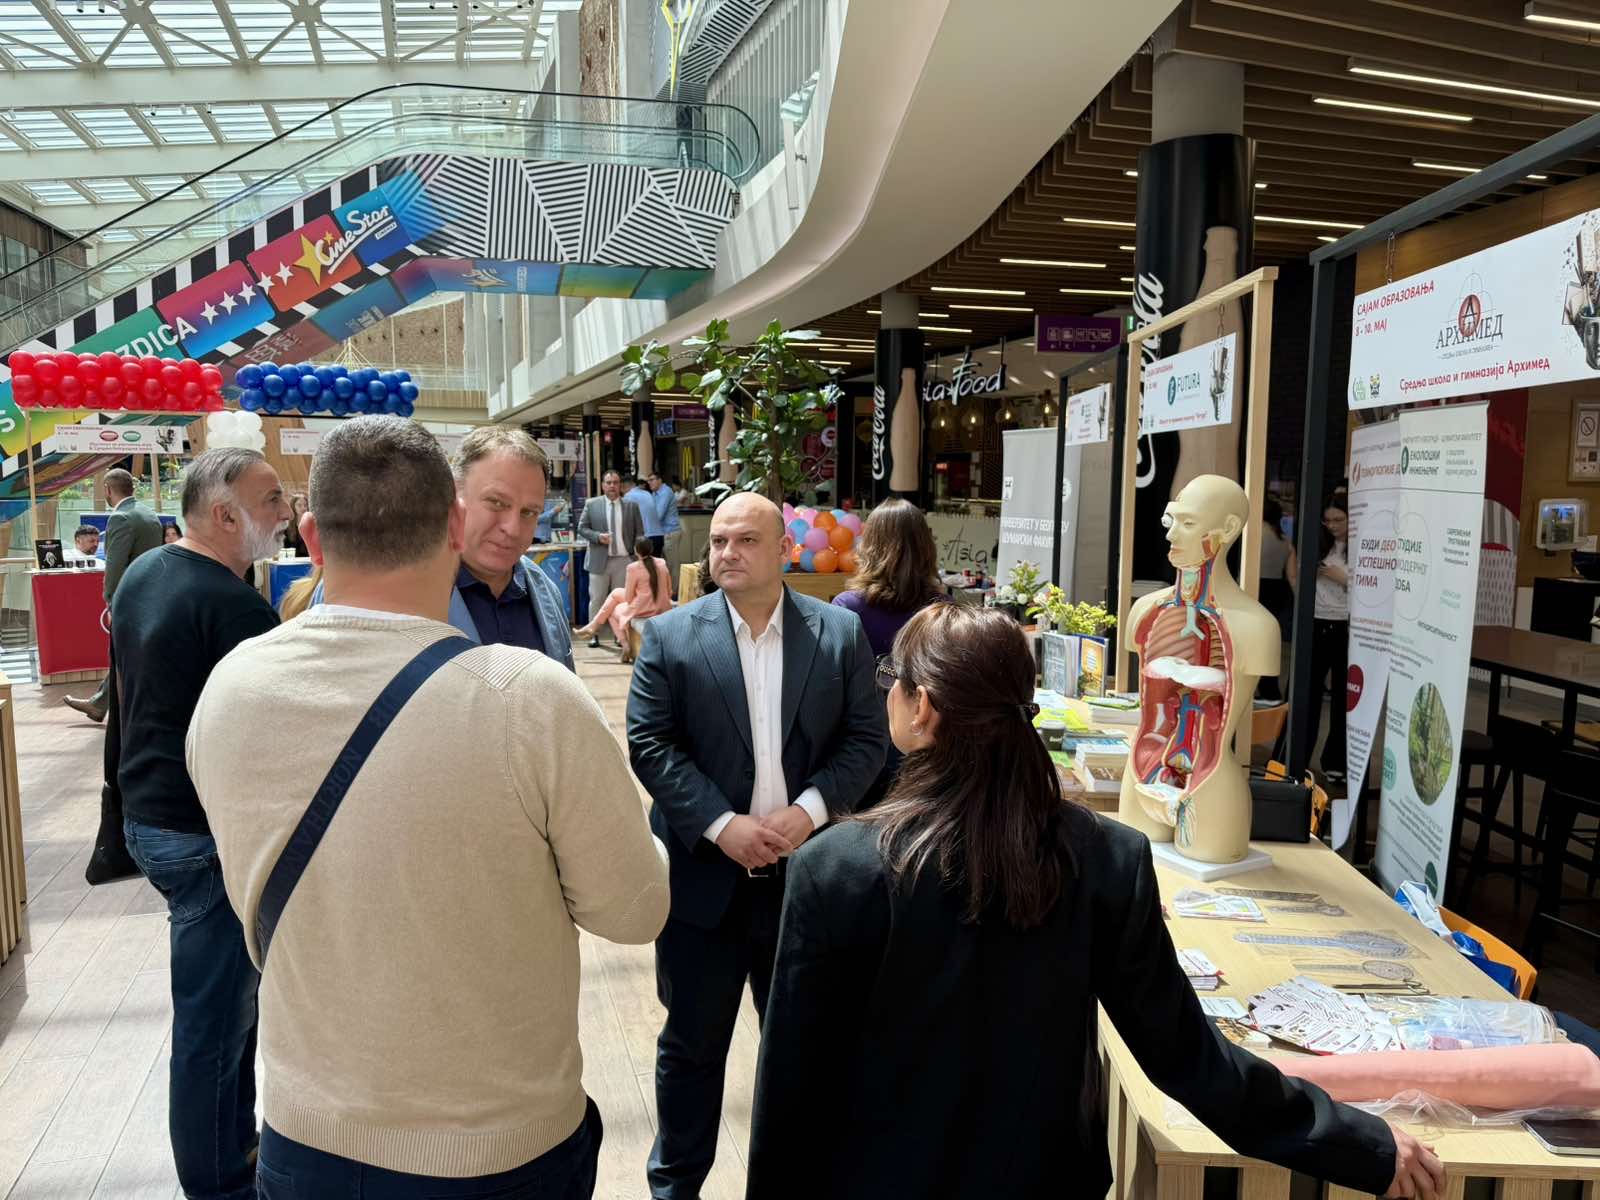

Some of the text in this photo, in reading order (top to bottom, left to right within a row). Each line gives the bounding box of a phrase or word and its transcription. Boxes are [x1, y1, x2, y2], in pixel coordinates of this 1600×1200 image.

[1357, 280, 1434, 316] САЈАМ ОБРАЗОВАЊА
[1374, 318, 1388, 333] МАЈ
[1436, 314, 1504, 350] АРХИМЕД
[1177, 371, 1201, 392] FUTURA
[1428, 374, 1451, 387] школа
[1461, 362, 1505, 381] гимназија
[1507, 356, 1550, 377] Архимед
[1361, 537, 1397, 553] БУДИ ДЕО
[1355, 574, 1378, 588] ТИМА
